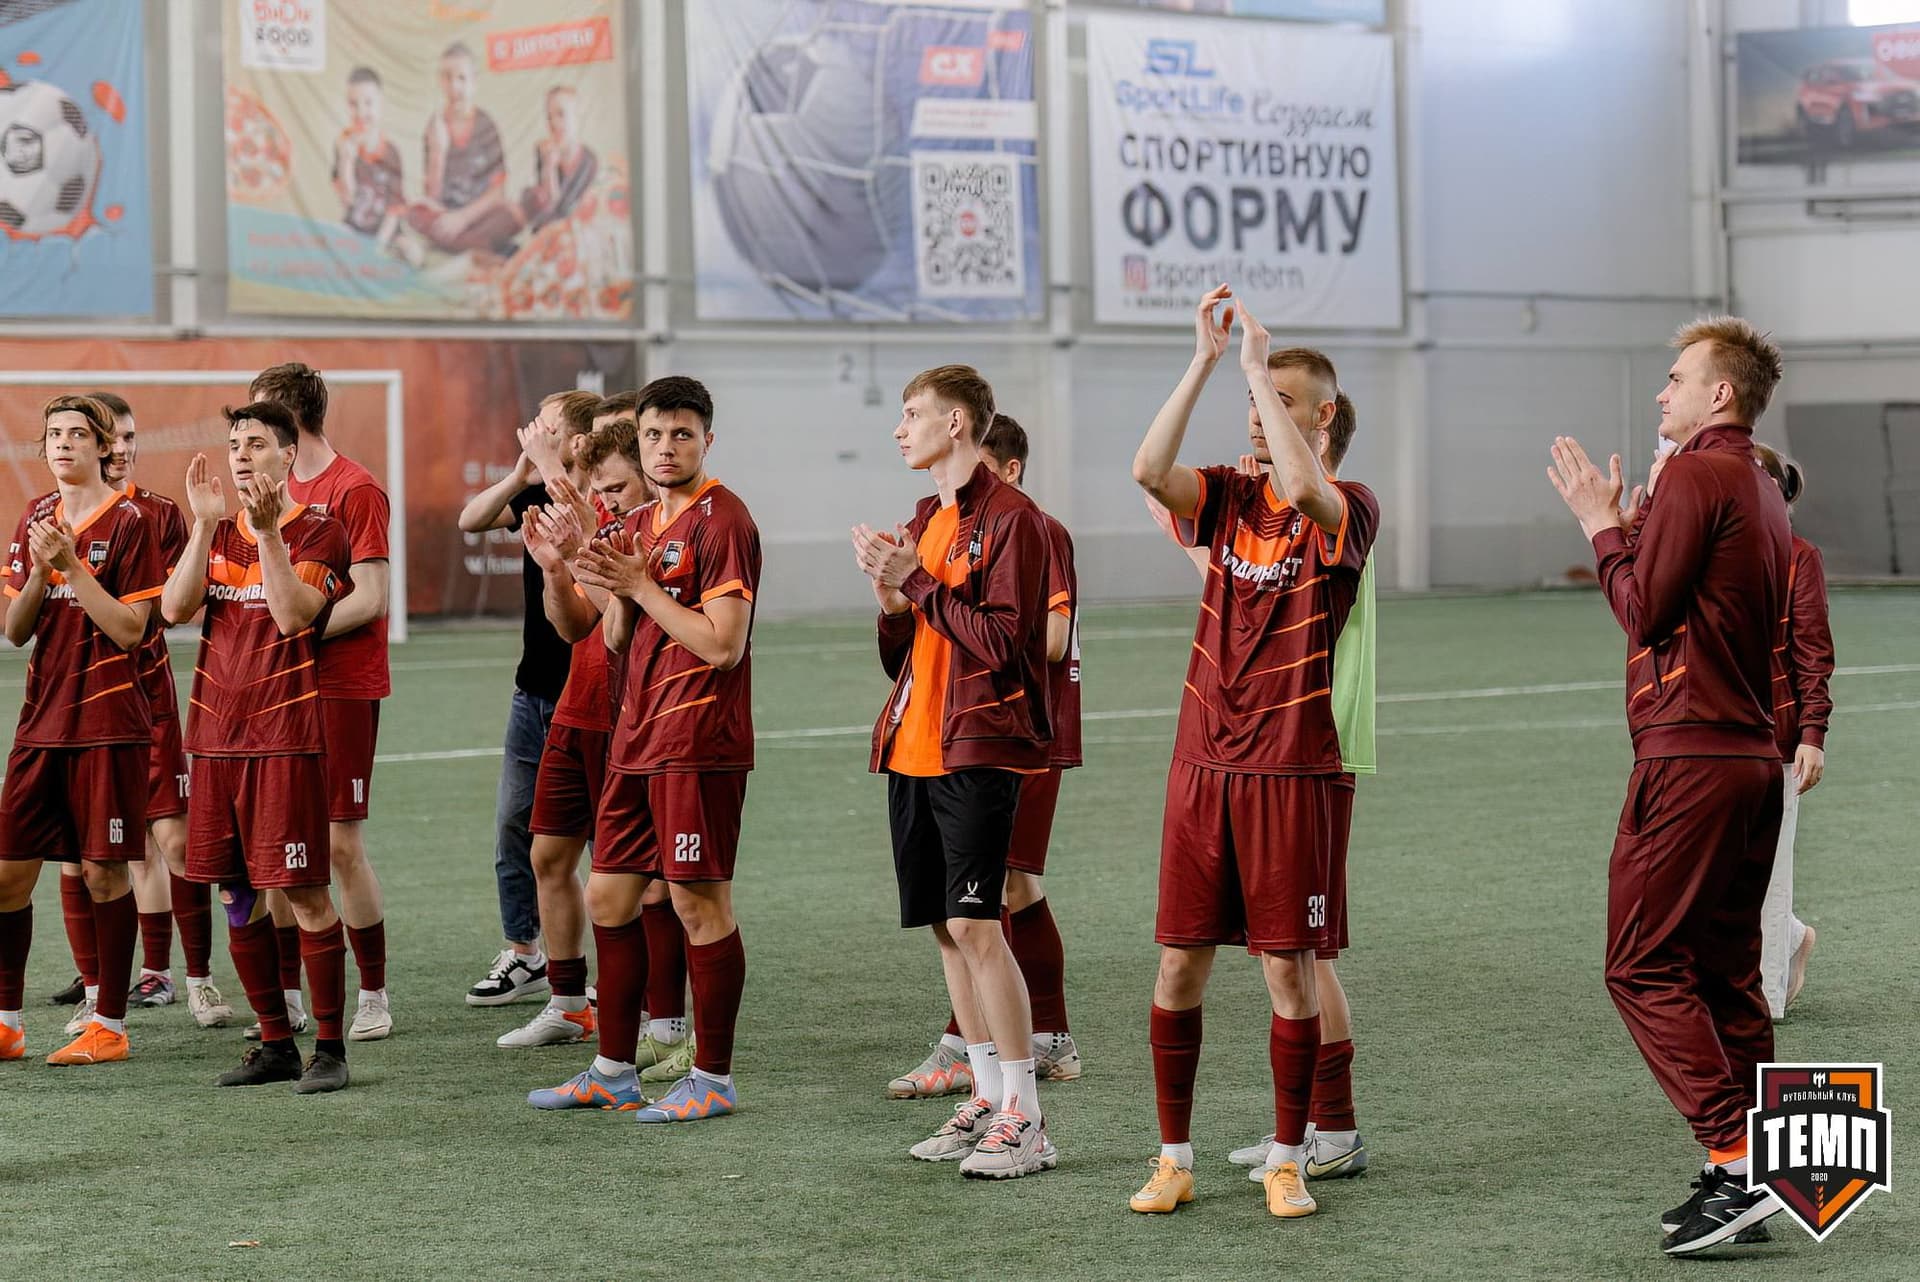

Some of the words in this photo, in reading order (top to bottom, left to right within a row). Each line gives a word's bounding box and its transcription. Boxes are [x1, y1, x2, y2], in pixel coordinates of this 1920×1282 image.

[1120, 132, 1371, 178] СПОРТИВНУЮ
[1122, 182, 1368, 253] ФОРМУ
[175, 774, 191, 798] 72
[109, 818, 123, 844] 66
[285, 842, 307, 869] 23
[675, 833, 700, 862] 22
[1308, 894, 1326, 928] 33
